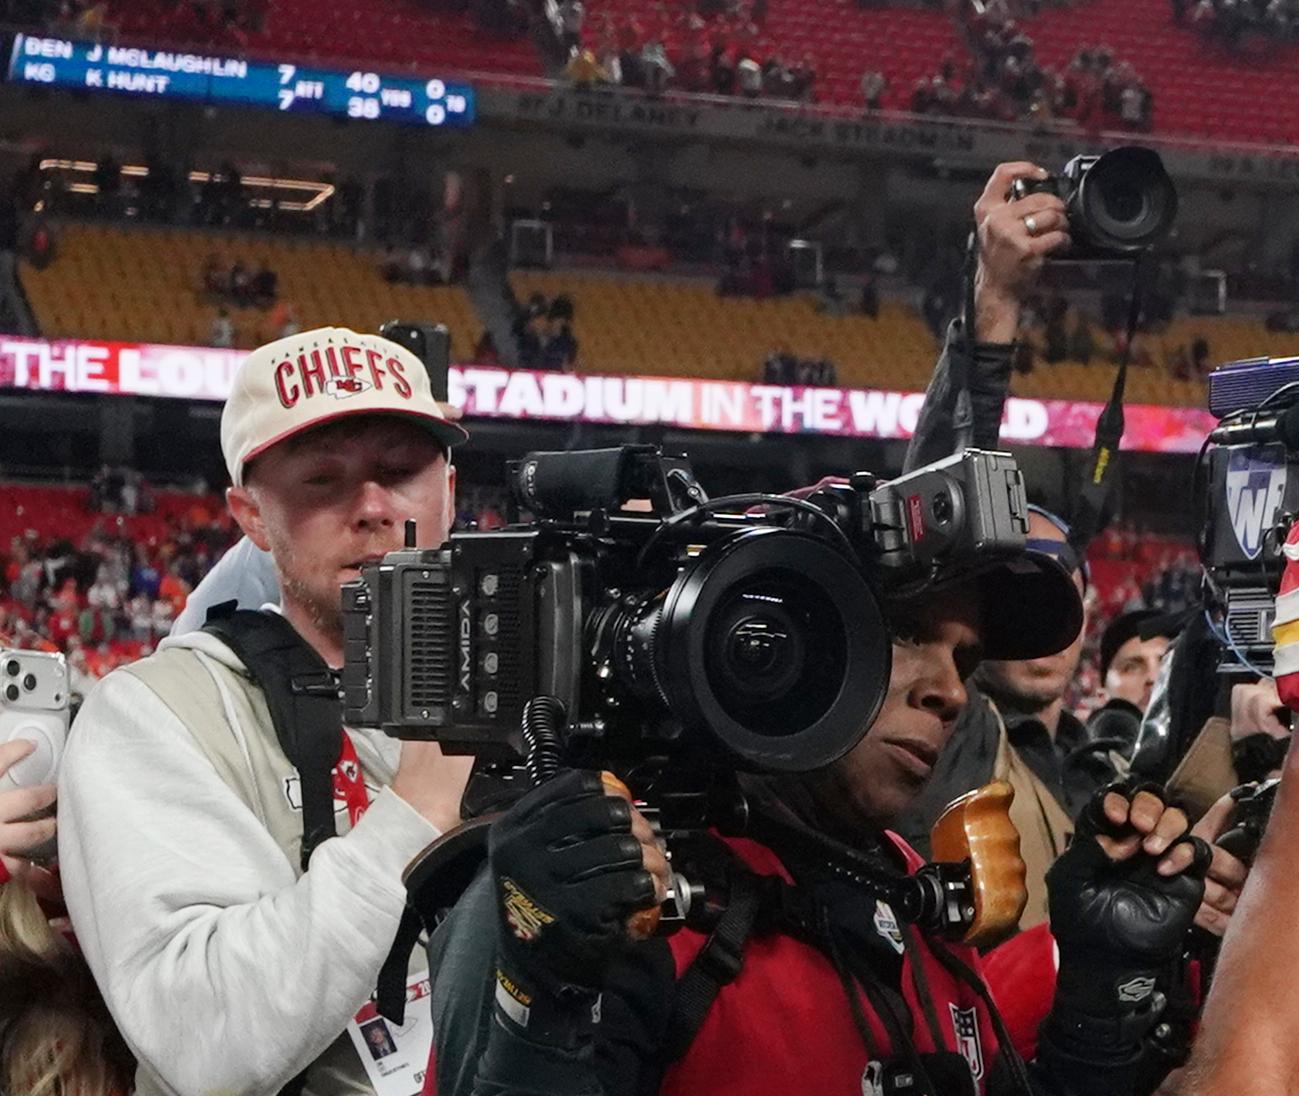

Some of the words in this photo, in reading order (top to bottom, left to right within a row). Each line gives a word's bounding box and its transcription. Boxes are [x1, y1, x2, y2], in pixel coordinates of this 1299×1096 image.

[25, 36, 73, 59] DEN
[86, 45, 103, 62] J
[107, 46, 247, 79] MCLAUGHLIN
[278, 64, 296, 84] 7
[346, 71, 380, 93] 40
[426, 79, 445, 100] 0
[86, 68, 103, 87] K
[107, 70, 170, 94] HUNT
[278, 89, 294, 110] 7
[426, 104, 445, 125] 0
[1, 339, 110, 391] THE
[695, 382, 747, 424] IN
[753, 383, 845, 430] THE
[274, 346, 413, 409] CHIEFS
